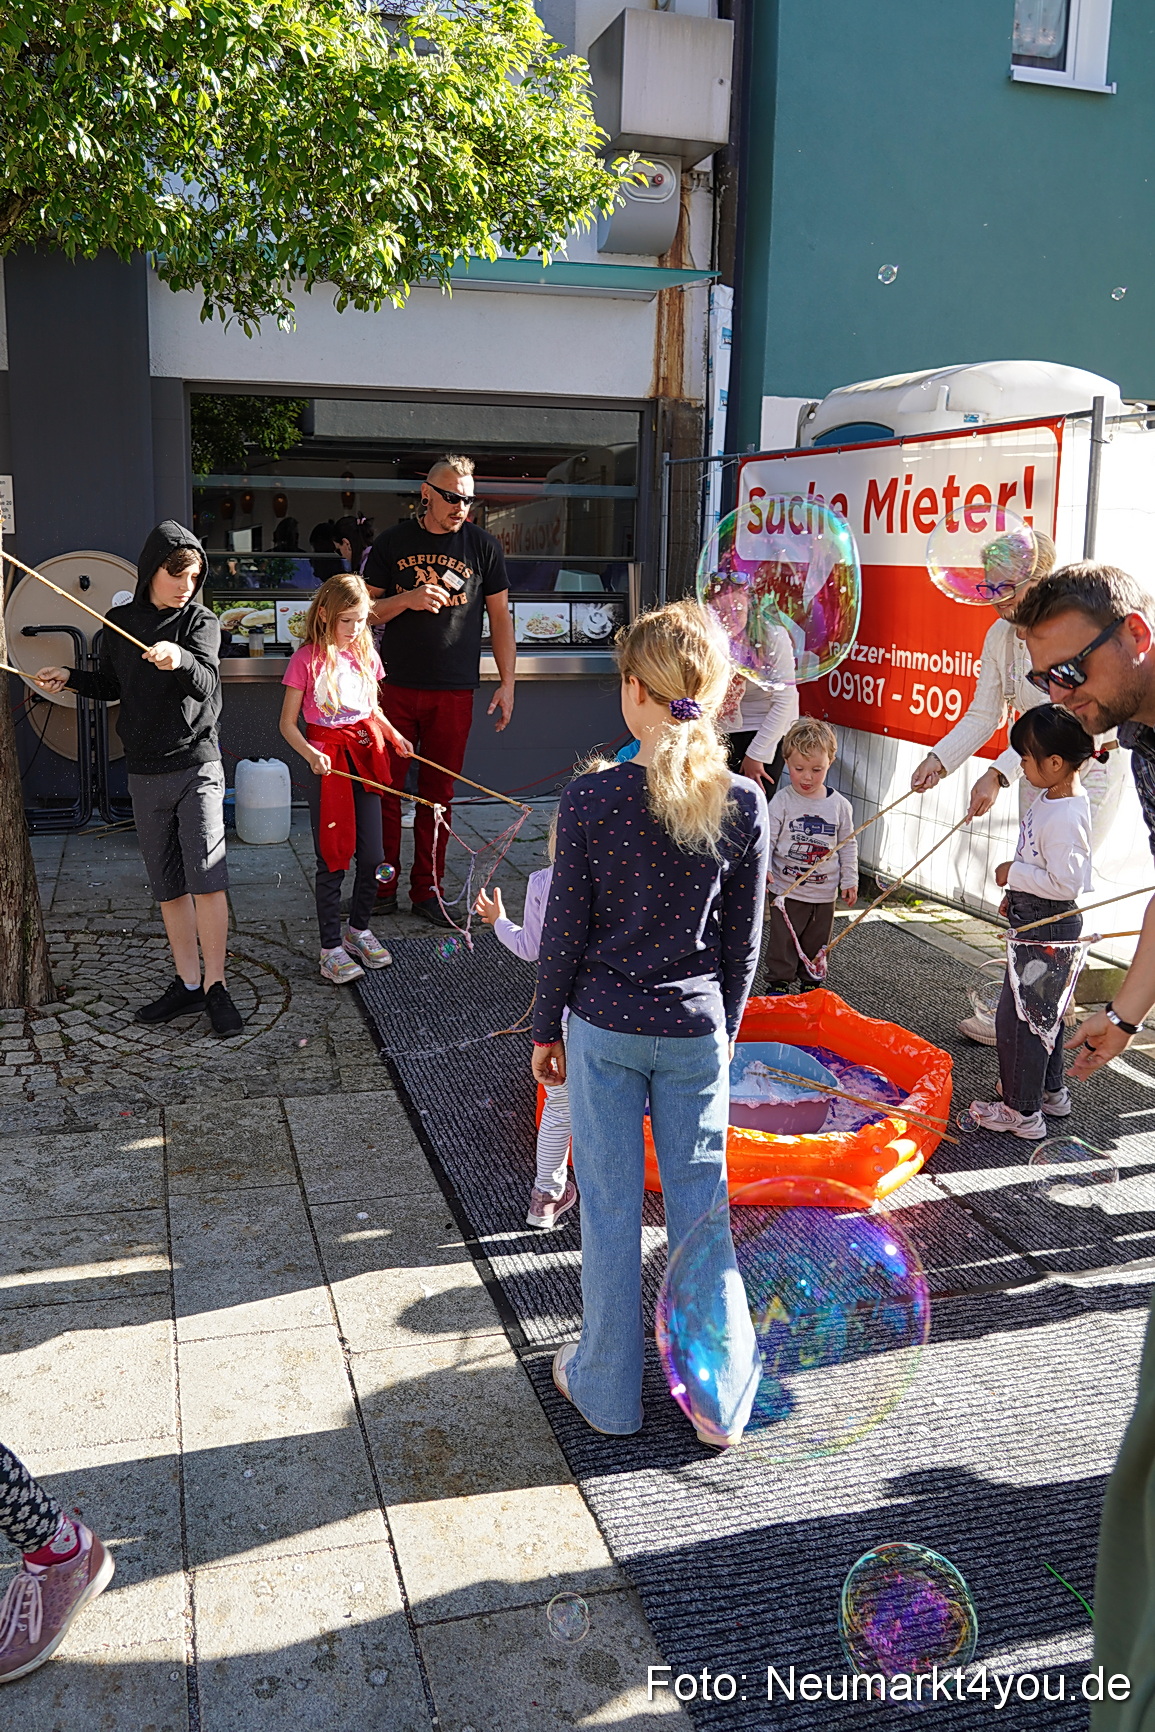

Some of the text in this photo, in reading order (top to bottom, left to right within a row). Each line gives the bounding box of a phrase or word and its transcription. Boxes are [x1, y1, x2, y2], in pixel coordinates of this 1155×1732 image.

[747, 465, 1035, 535] Suche Mieter!
[397, 554, 474, 579] REFUGEES
[828, 669, 886, 707] 09181
[909, 683, 962, 721] 509
